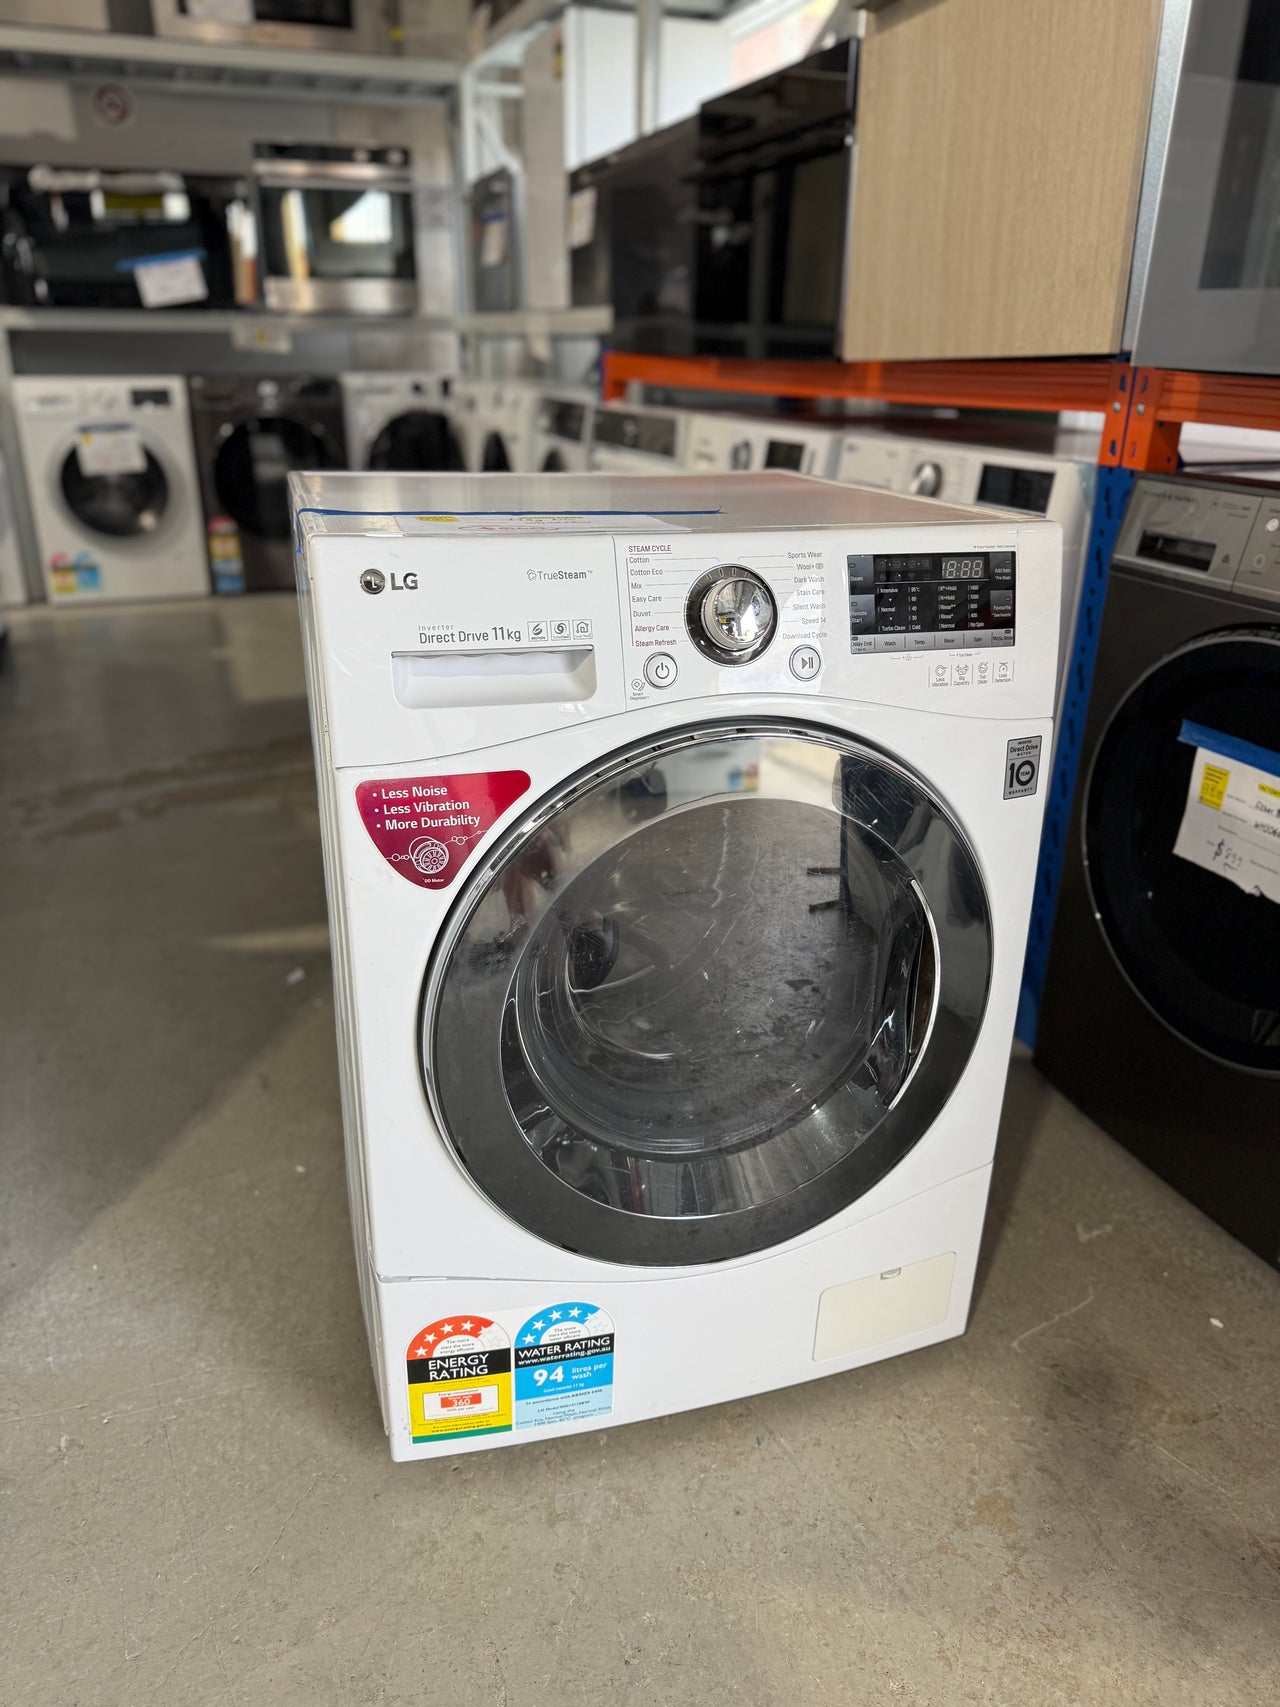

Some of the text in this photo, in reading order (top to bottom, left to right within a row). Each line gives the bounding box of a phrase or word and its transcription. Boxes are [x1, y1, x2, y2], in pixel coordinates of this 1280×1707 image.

[390, 573, 418, 591] LG
[419, 632, 455, 645] Direct
[458, 630, 489, 643] Drive
[492, 626, 522, 643] 11kg
[655, 639, 677, 647] Refresh
[811, 631, 828, 639] Cycle
[1009, 760, 1035, 788] 10
[382, 786, 448, 799] Less Noise
[384, 801, 470, 815] Less Vibration
[385, 815, 480, 831] More Durability
[518, 1337, 610, 1358] WATER RATING
[518, 1346, 611, 1365] www.waterrating.gov.au
[428, 1353, 489, 1371] ENERGY
[429, 1365, 488, 1381] RATING
[533, 1363, 608, 1386] 94 litres per
[572, 1371, 592, 1379] wash
[452, 1398, 471, 1406] 360
